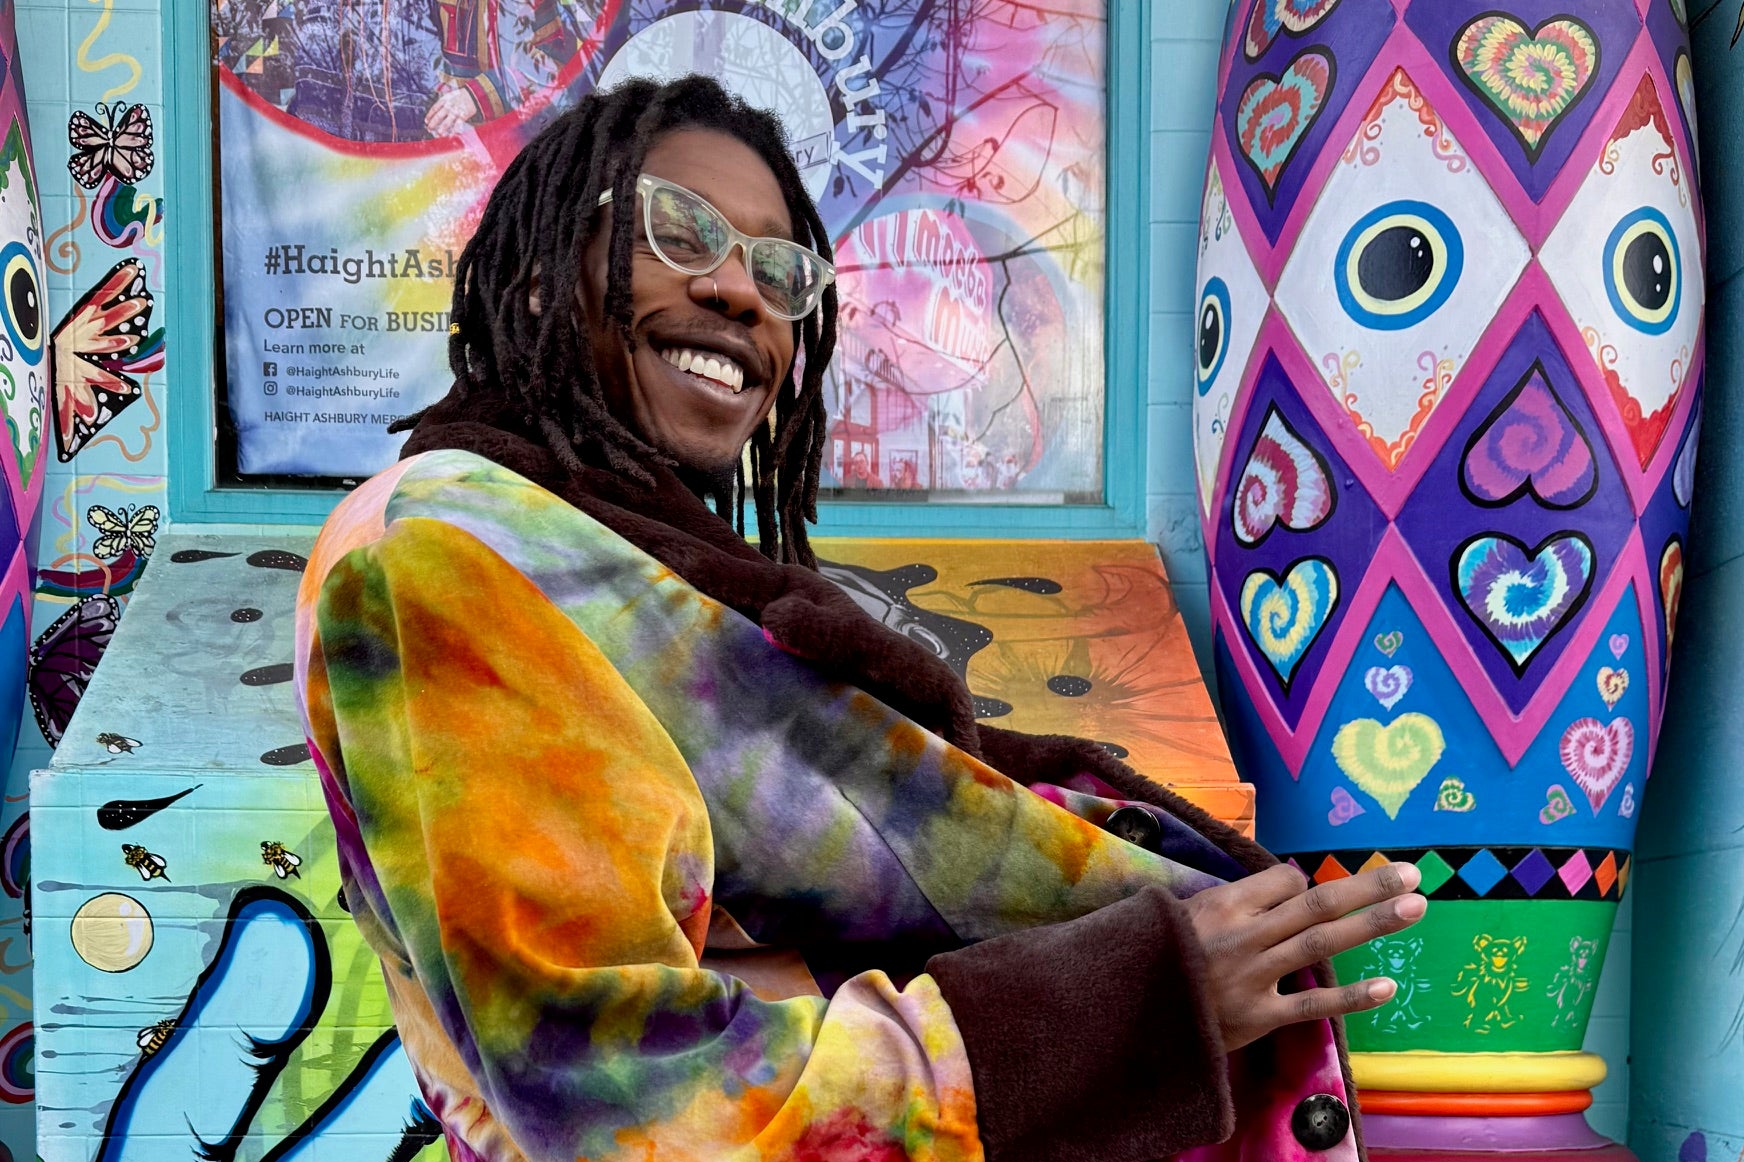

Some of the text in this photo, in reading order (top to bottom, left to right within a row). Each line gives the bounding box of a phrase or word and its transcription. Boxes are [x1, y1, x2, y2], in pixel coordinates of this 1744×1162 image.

[264, 307, 333, 330] OPEN
[340, 314, 380, 331] FOR
[263, 338, 366, 356] Learn more at
[286, 365, 400, 381] @HaightAshburyLife
[286, 384, 400, 400] @HaightAshburyLife
[264, 411, 310, 423] HAIGHT
[312, 412, 368, 424] ASHBURY
